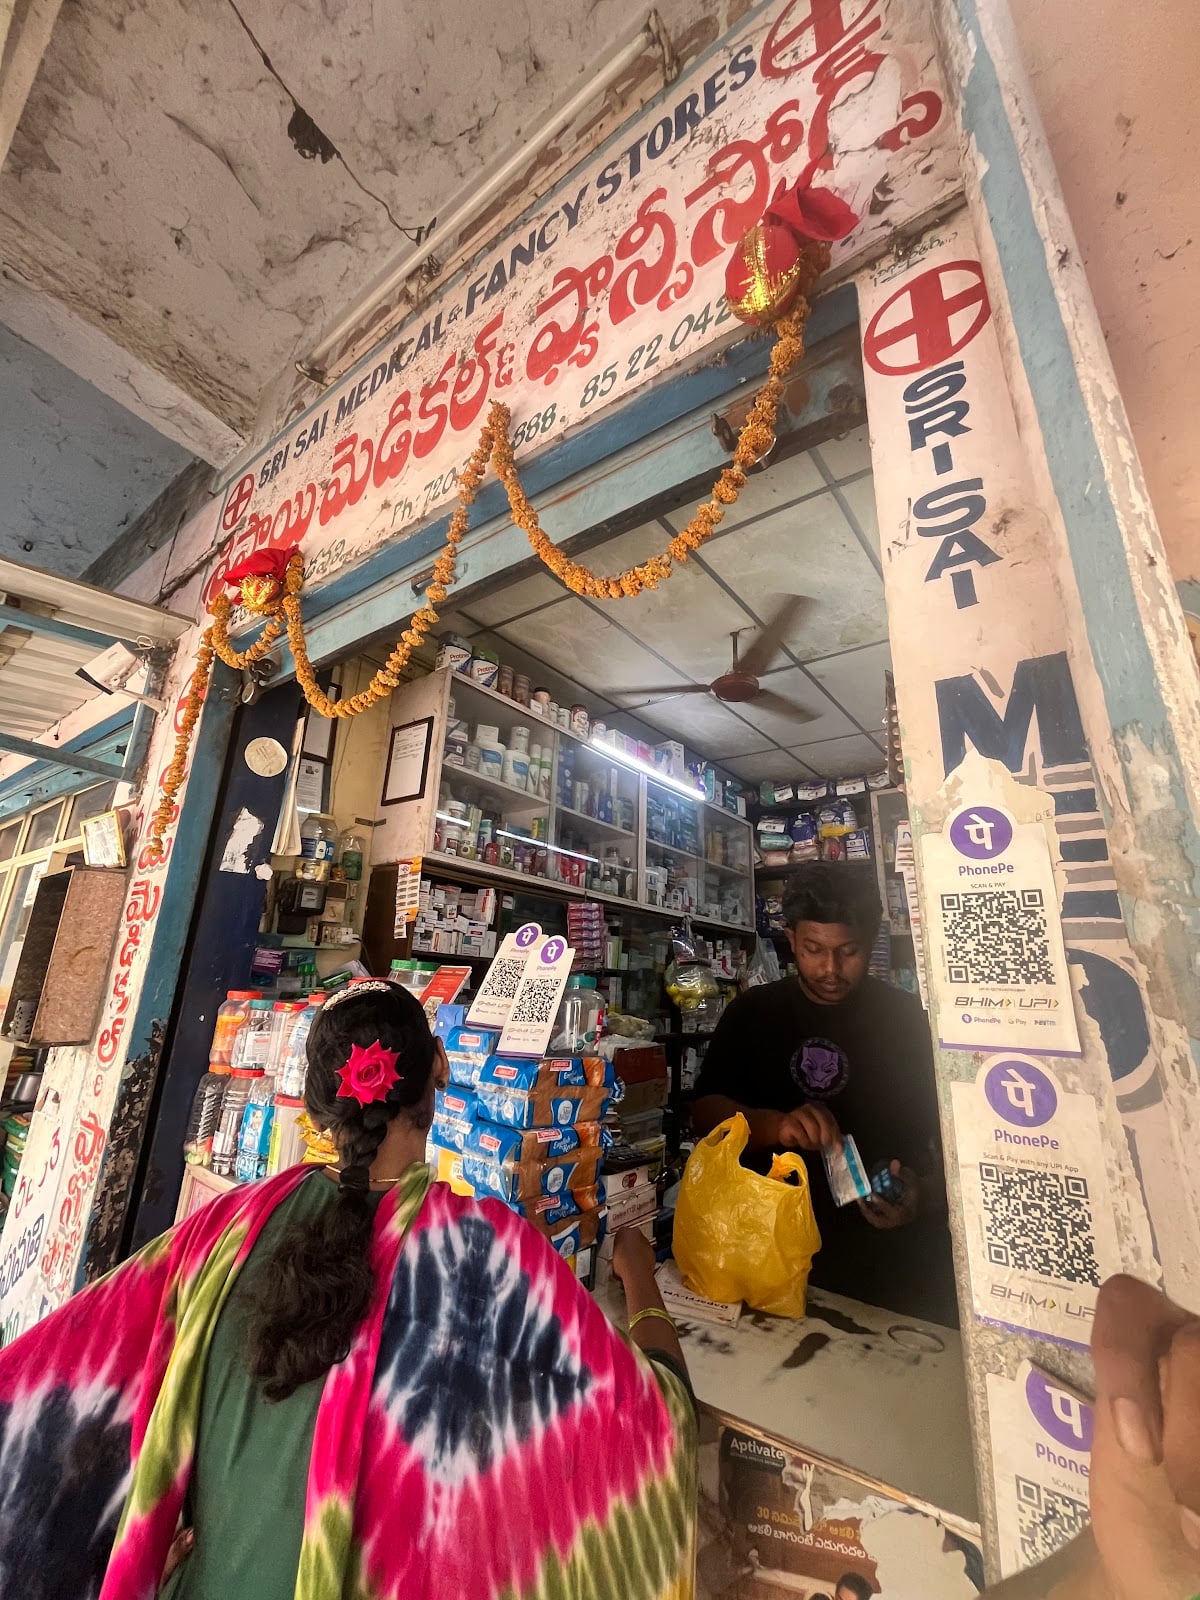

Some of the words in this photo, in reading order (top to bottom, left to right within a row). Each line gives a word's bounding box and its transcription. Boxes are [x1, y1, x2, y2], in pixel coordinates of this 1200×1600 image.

[258, 445, 290, 489] SRI
[293, 410, 330, 459] SAI
[334, 312, 447, 427] MEDICAL
[465, 183, 590, 319] FANCY
[596, 45, 757, 205] STORES
[580, 361, 619, 409] 85
[625, 334, 664, 382] 22
[902, 360, 974, 476] SRI
[912, 478, 1004, 610] SAI
[958, 863, 1015, 877] PhonePe
[970, 882, 988, 890] SCAN
[954, 996, 1005, 1008] BHIM
[1018, 998, 1053, 1009] UPI
[994, 1128, 1060, 1150] PhonePe
[982, 1152, 999, 1162] Scan
[1006, 1155, 1018, 1166] Pay
[1020, 1157, 1035, 1167] with
[1036, 1161, 1049, 1170] any
[1050, 1162, 1063, 1170] UPI
[1064, 1163, 1079, 1174] App
[990, 1284, 1048, 1309] BHIM
[730, 1437, 784, 1460] Aptivate
[1035, 1442, 1090, 1478] Phone
[1051, 1475, 1074, 1493] SCAN
[757, 1505, 770, 1519] 30
